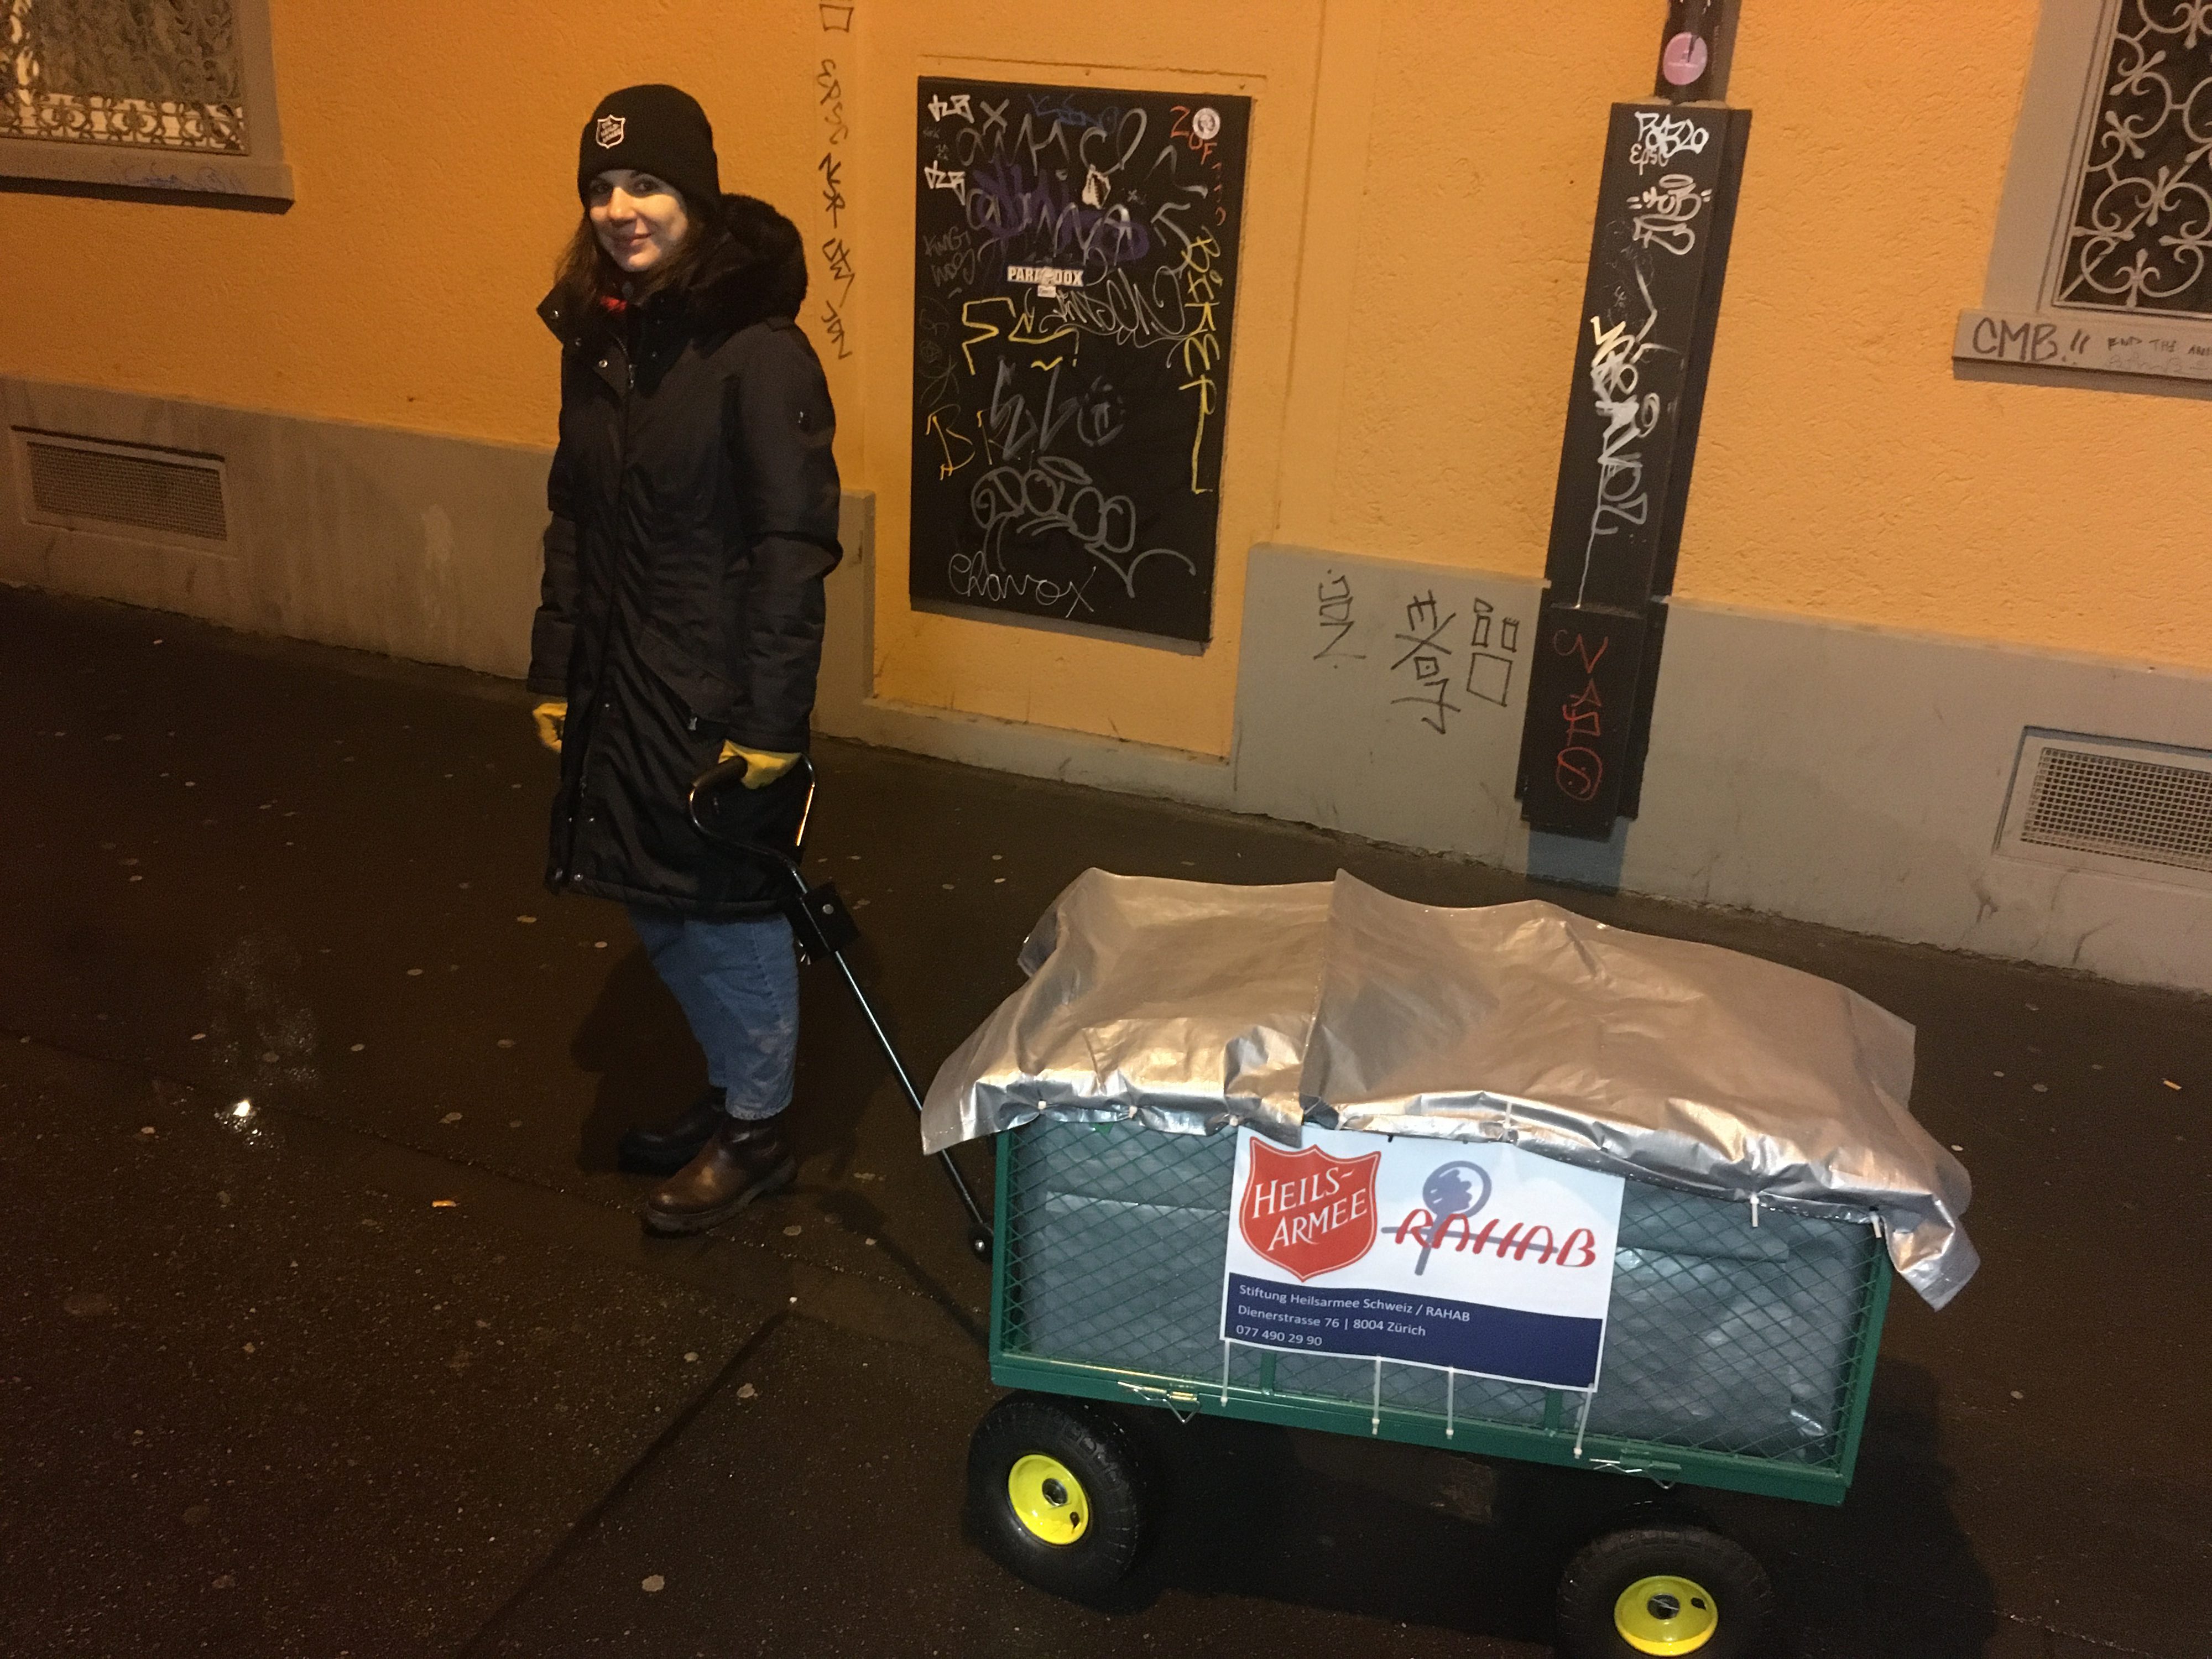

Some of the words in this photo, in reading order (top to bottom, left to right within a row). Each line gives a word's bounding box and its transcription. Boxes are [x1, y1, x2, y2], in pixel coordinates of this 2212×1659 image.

[1251, 1167, 1355, 1219] HEILS-
[1266, 1188, 1368, 1251] ARMEE
[1395, 1209, 1597, 1267] RAHAB
[1238, 1305, 1321, 1326] Dienerstrasse
[1324, 1317, 1340, 1328] 76
[1353, 1318, 1384, 1331] 8004
[1386, 1321, 1426, 1336] Zürich
[1239, 1284, 1287, 1304] Stiftung
[1291, 1293, 1360, 1308] Heilsarmee
[1363, 1298, 1413, 1314] Schweiz
[1415, 1303, 1424, 1316] /
[1426, 1306, 1471, 1322] RAHAB
[1236, 1324, 1260, 1338] 077
[1261, 1329, 1286, 1342] 490
[1288, 1333, 1304, 1344] 29
[1306, 1335, 1323, 1347] 90
